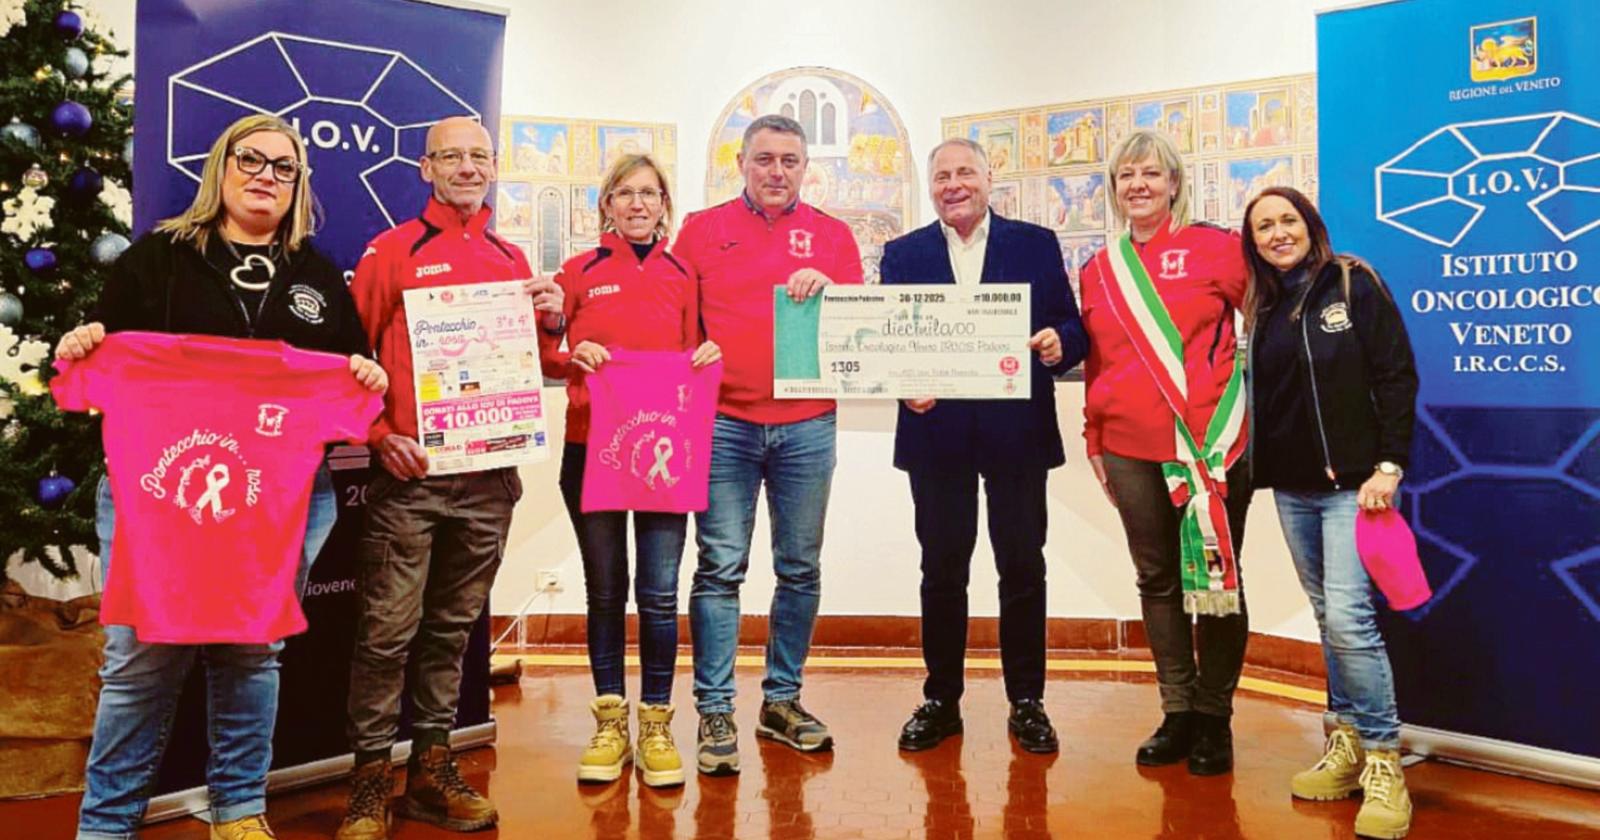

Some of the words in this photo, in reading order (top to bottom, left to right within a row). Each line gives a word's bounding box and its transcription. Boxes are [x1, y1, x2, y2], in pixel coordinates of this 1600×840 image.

[1449, 86, 1497, 101] REGIONE
[1515, 77, 1560, 91] VENETO
[1467, 167, 1548, 196] I.O.V.
[1441, 250, 1578, 277] ISTITUTO
[1450, 322, 1572, 345] VENETO
[831, 361, 860, 372] 1305
[1453, 355, 1565, 372] I.R.C.C.S.
[443, 406, 513, 428] 10.000
[140, 429, 222, 499] Pontecchio
